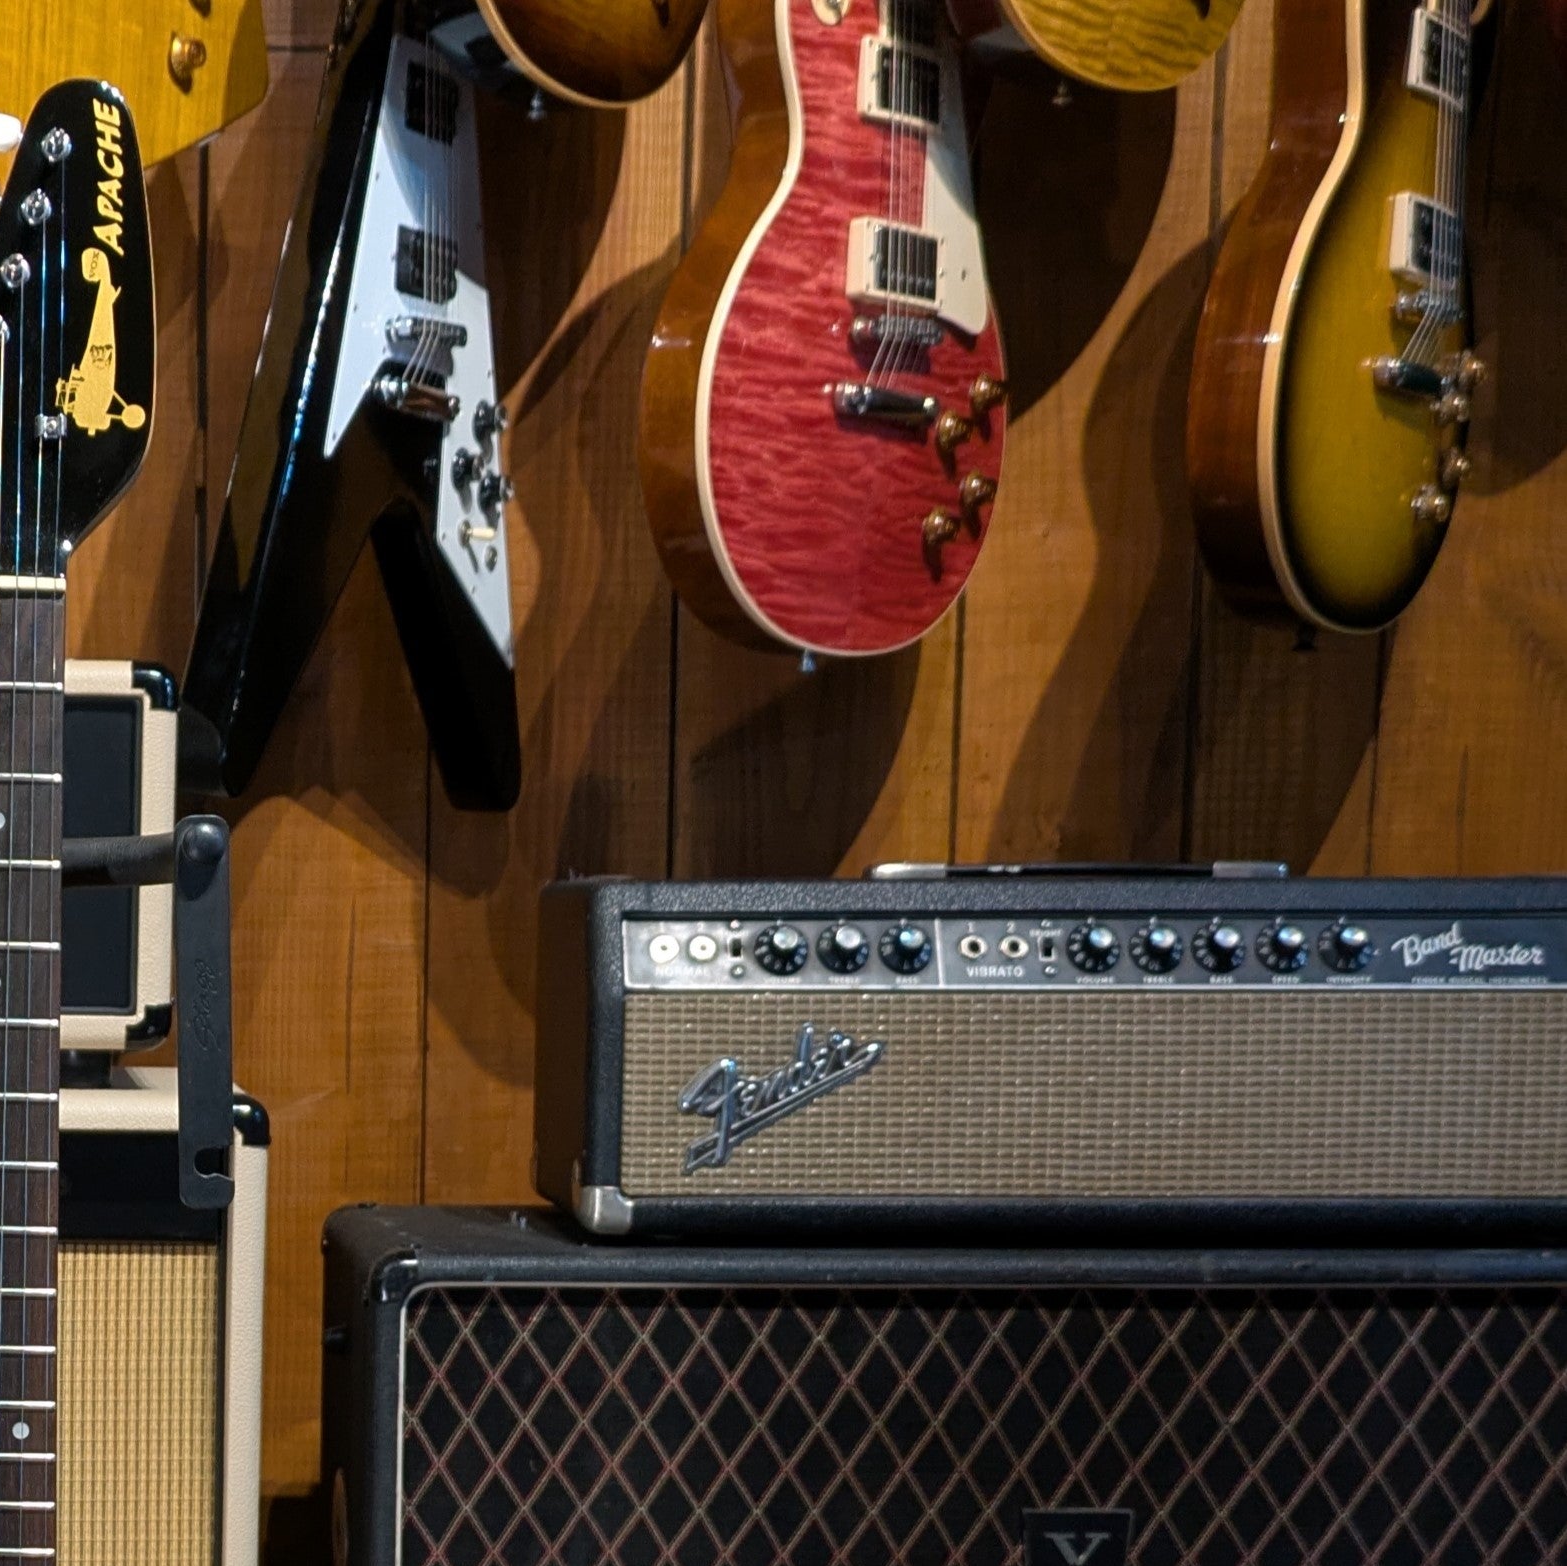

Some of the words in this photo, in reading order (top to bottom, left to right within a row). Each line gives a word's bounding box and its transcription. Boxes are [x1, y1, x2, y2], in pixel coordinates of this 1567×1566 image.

[92, 98, 124, 257] APACHE
[88, 251, 100, 279] VOX
[966, 921, 975, 933] 1
[1006, 921, 1016, 934] 2
[1391, 920, 1464, 967] Band
[1449, 943, 1545, 972] Master
[655, 966, 712, 977] NORMAL
[966, 966, 1025, 977] VIBRATO
[895, 976, 919, 984] BASS
[1075, 976, 1115, 984] VOLUME
[1209, 976, 1234, 984] BASS
[678, 1021, 887, 1175] Fender
